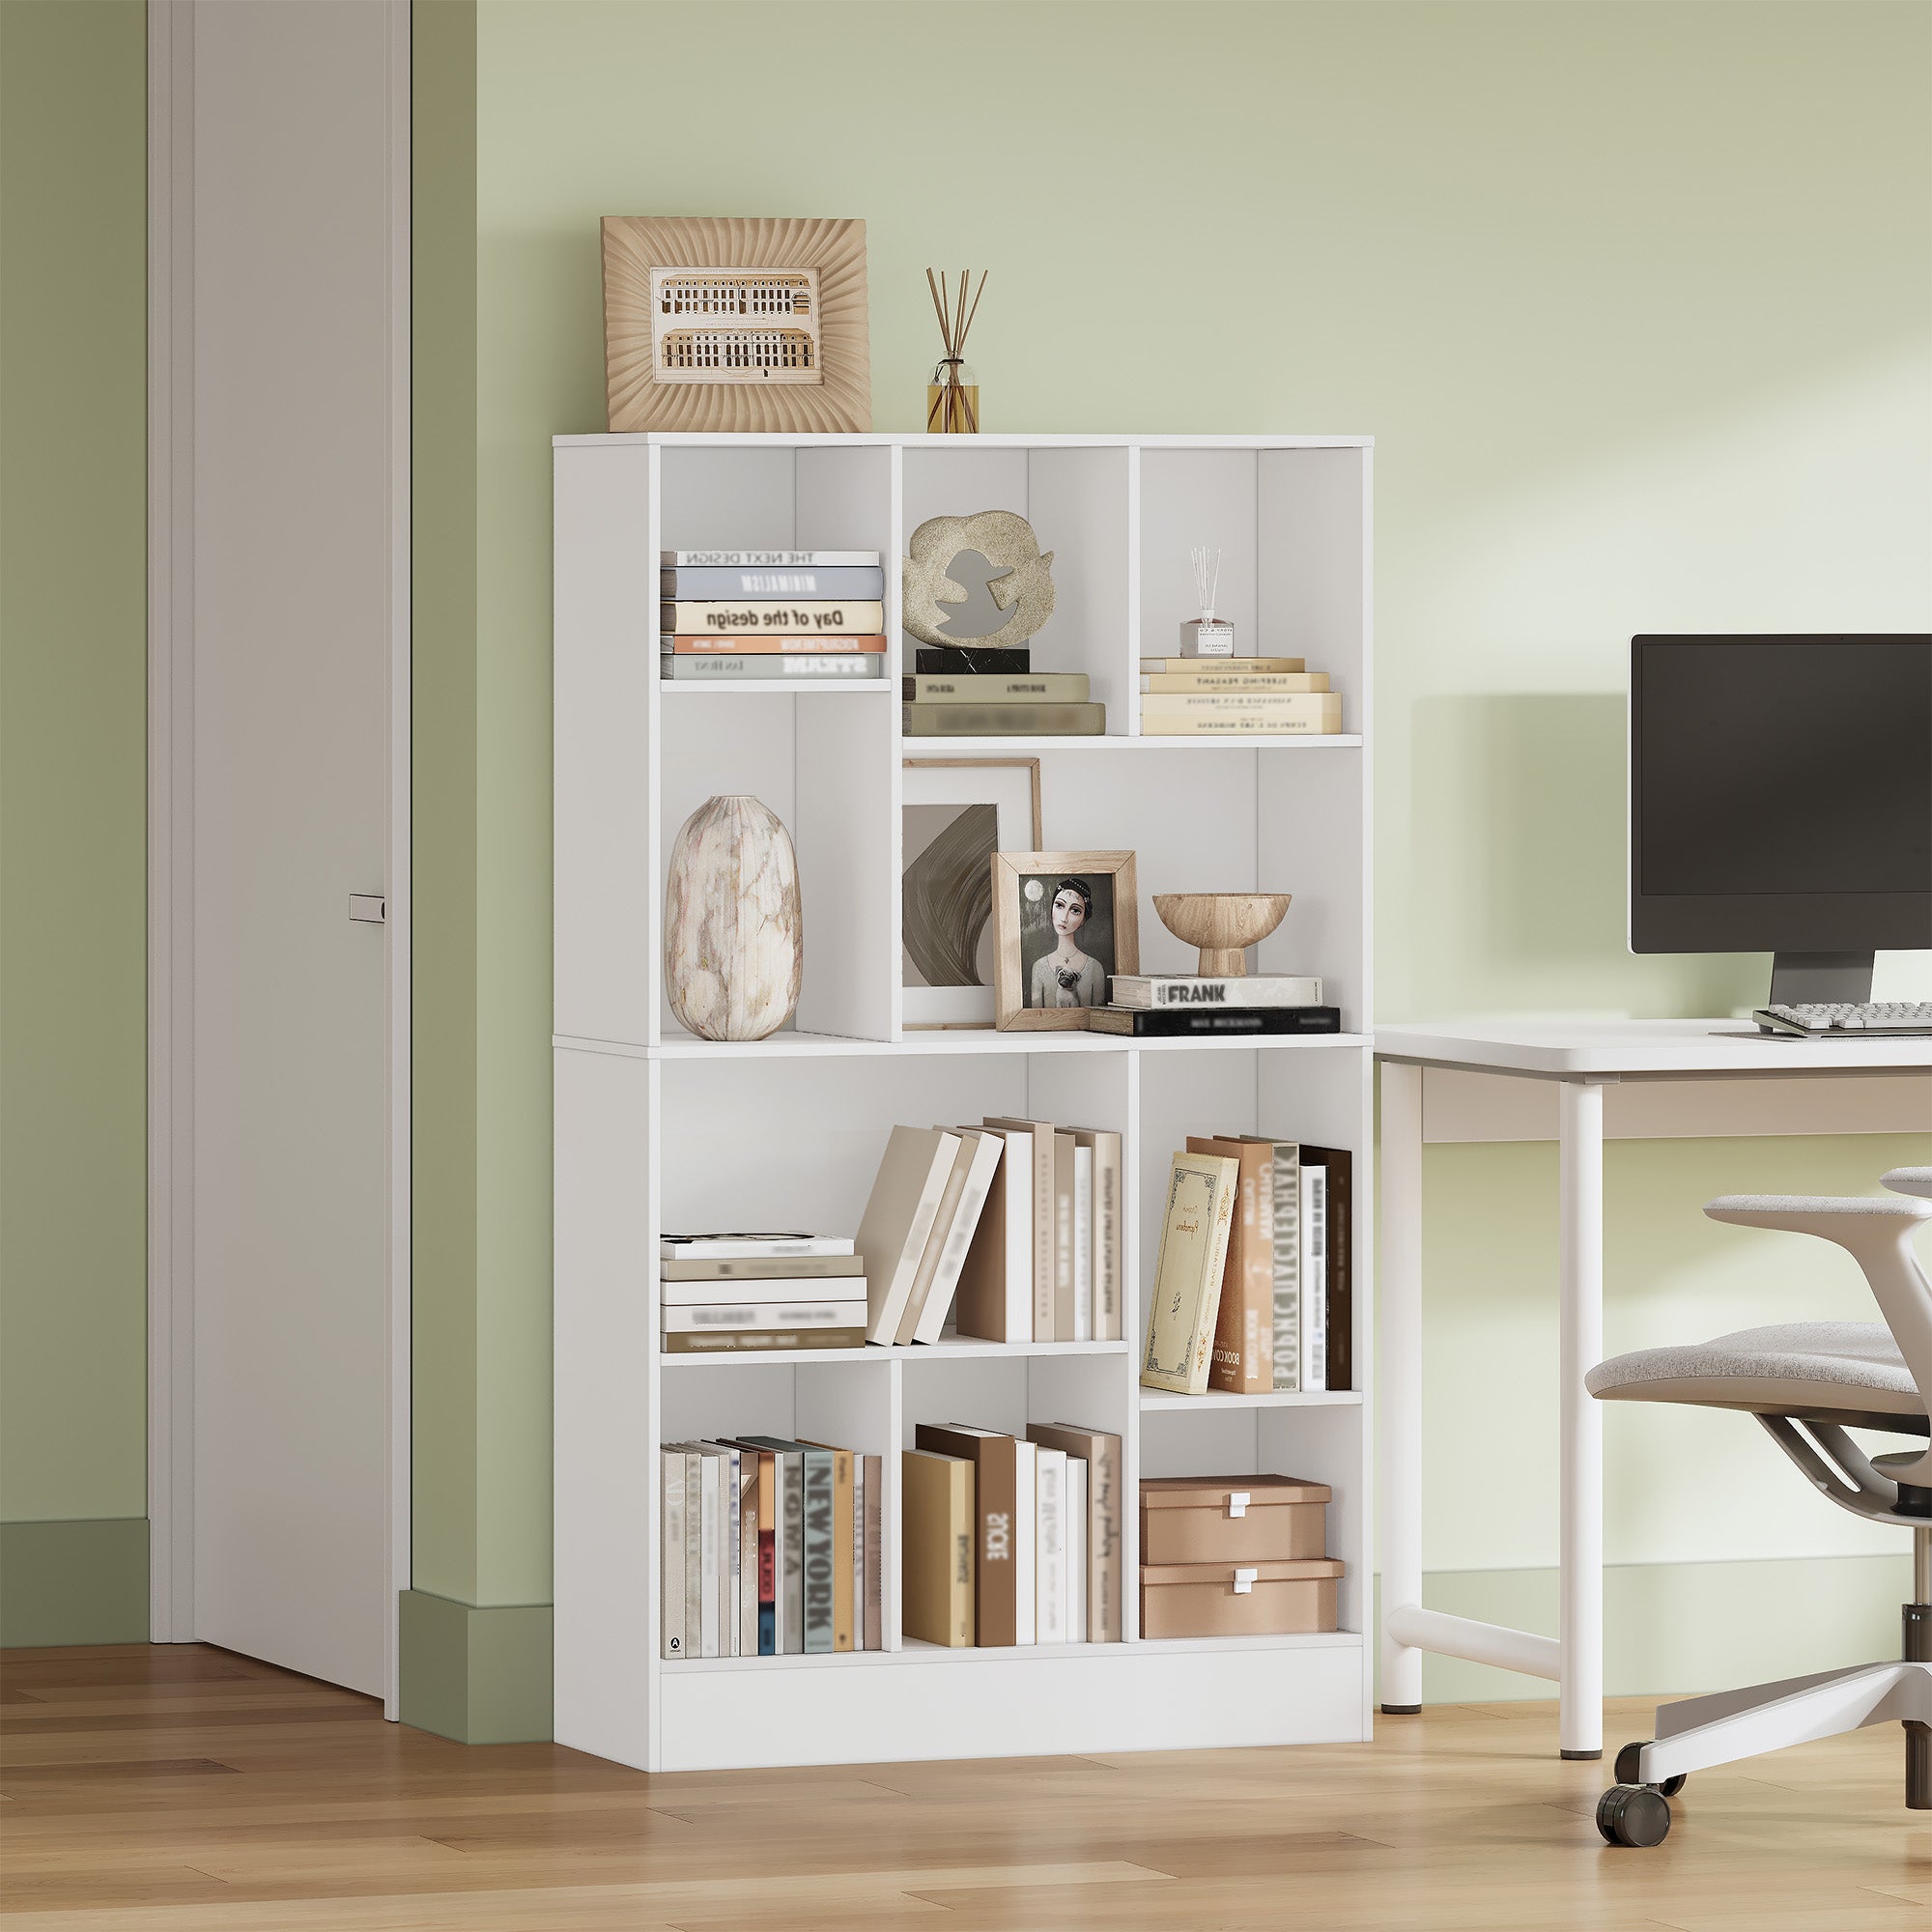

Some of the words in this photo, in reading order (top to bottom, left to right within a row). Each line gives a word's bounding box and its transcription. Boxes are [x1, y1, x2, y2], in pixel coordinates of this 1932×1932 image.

[1167, 983, 1226, 1003] FRANK
[784, 1463, 801, 1576] NOMA
[807, 1466, 833, 1534] NEW
[807, 1539, 833, 1631] YORK
